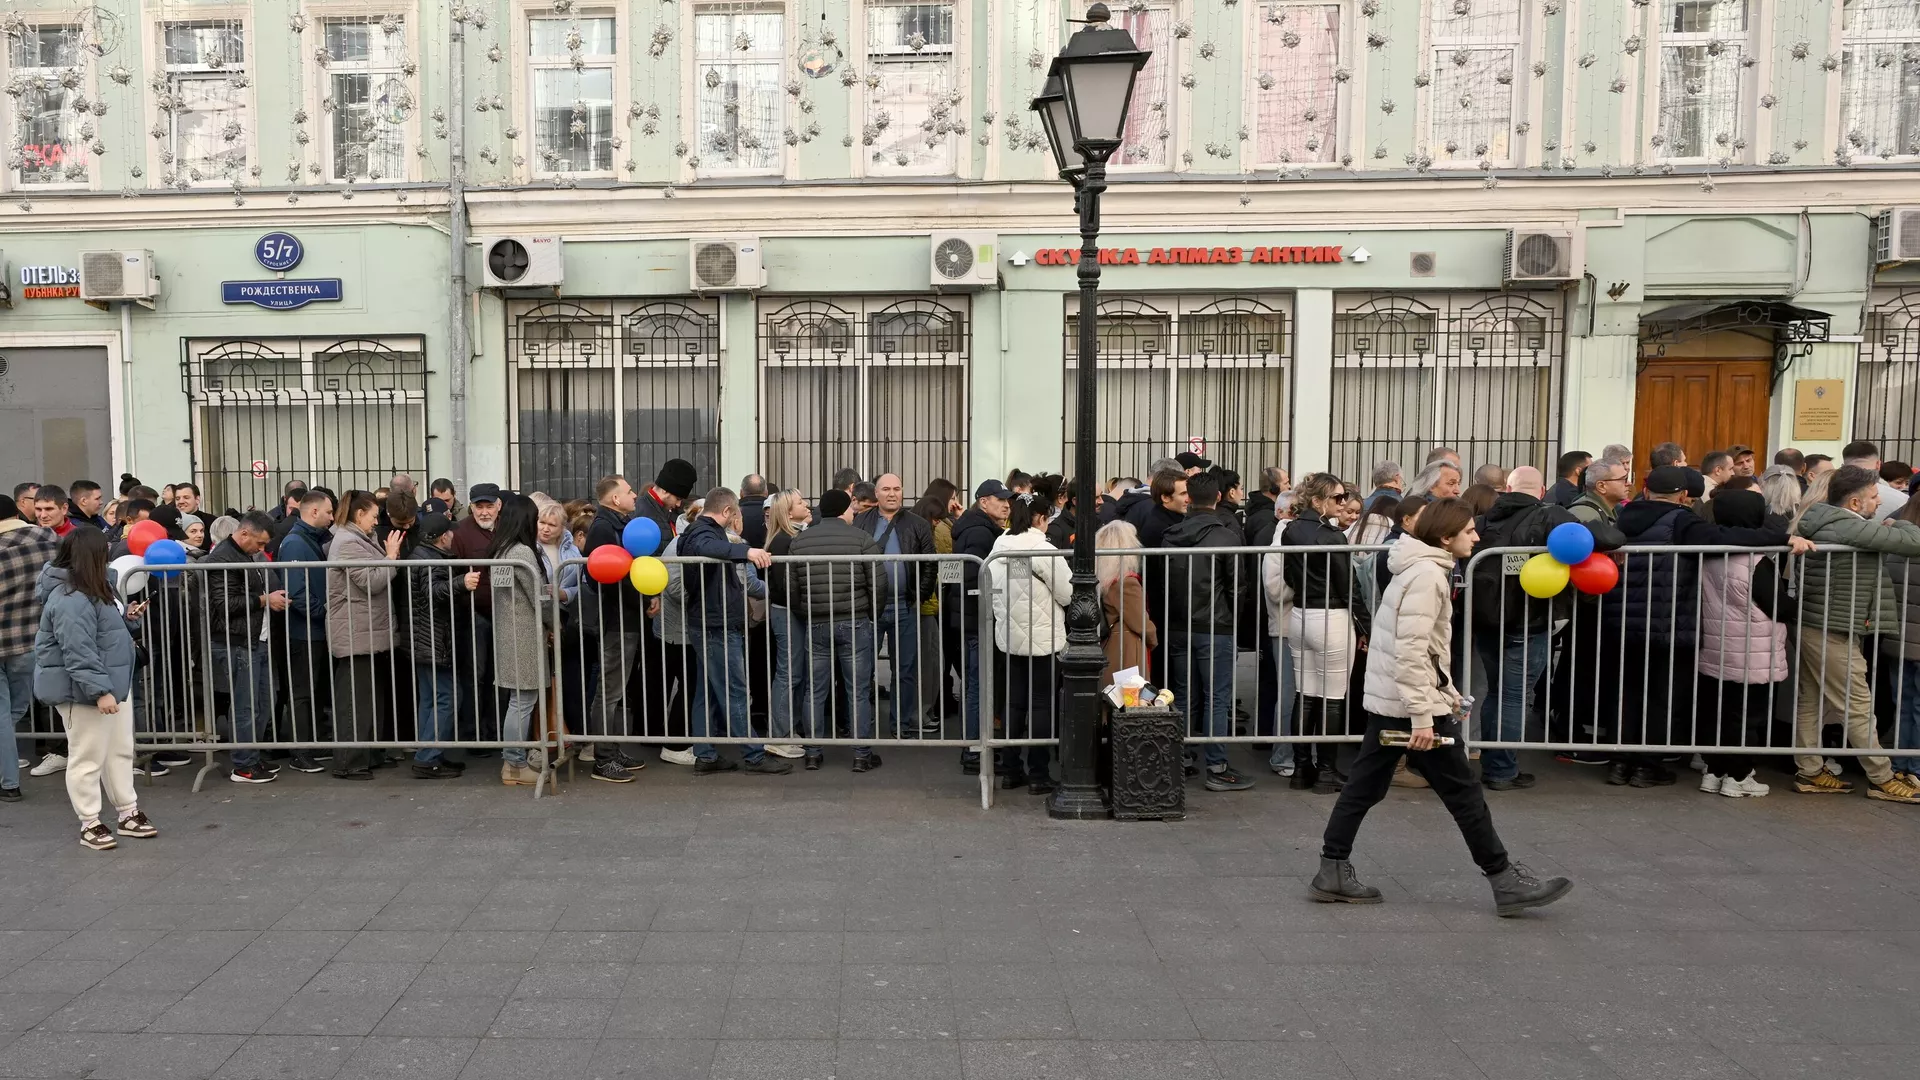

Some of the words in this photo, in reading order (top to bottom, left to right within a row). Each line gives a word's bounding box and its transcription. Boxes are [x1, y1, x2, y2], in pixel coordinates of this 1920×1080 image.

[263, 239, 294, 260] 5/7
[1035, 248, 1140, 265] СКУКА
[1147, 247, 1244, 264] АЛМАЗ
[1250, 246, 1343, 263] АНТИК
[21, 265, 67, 285] ОТЕЛЬ
[241, 285, 320, 296] РОЖДЕСТВЕНКА
